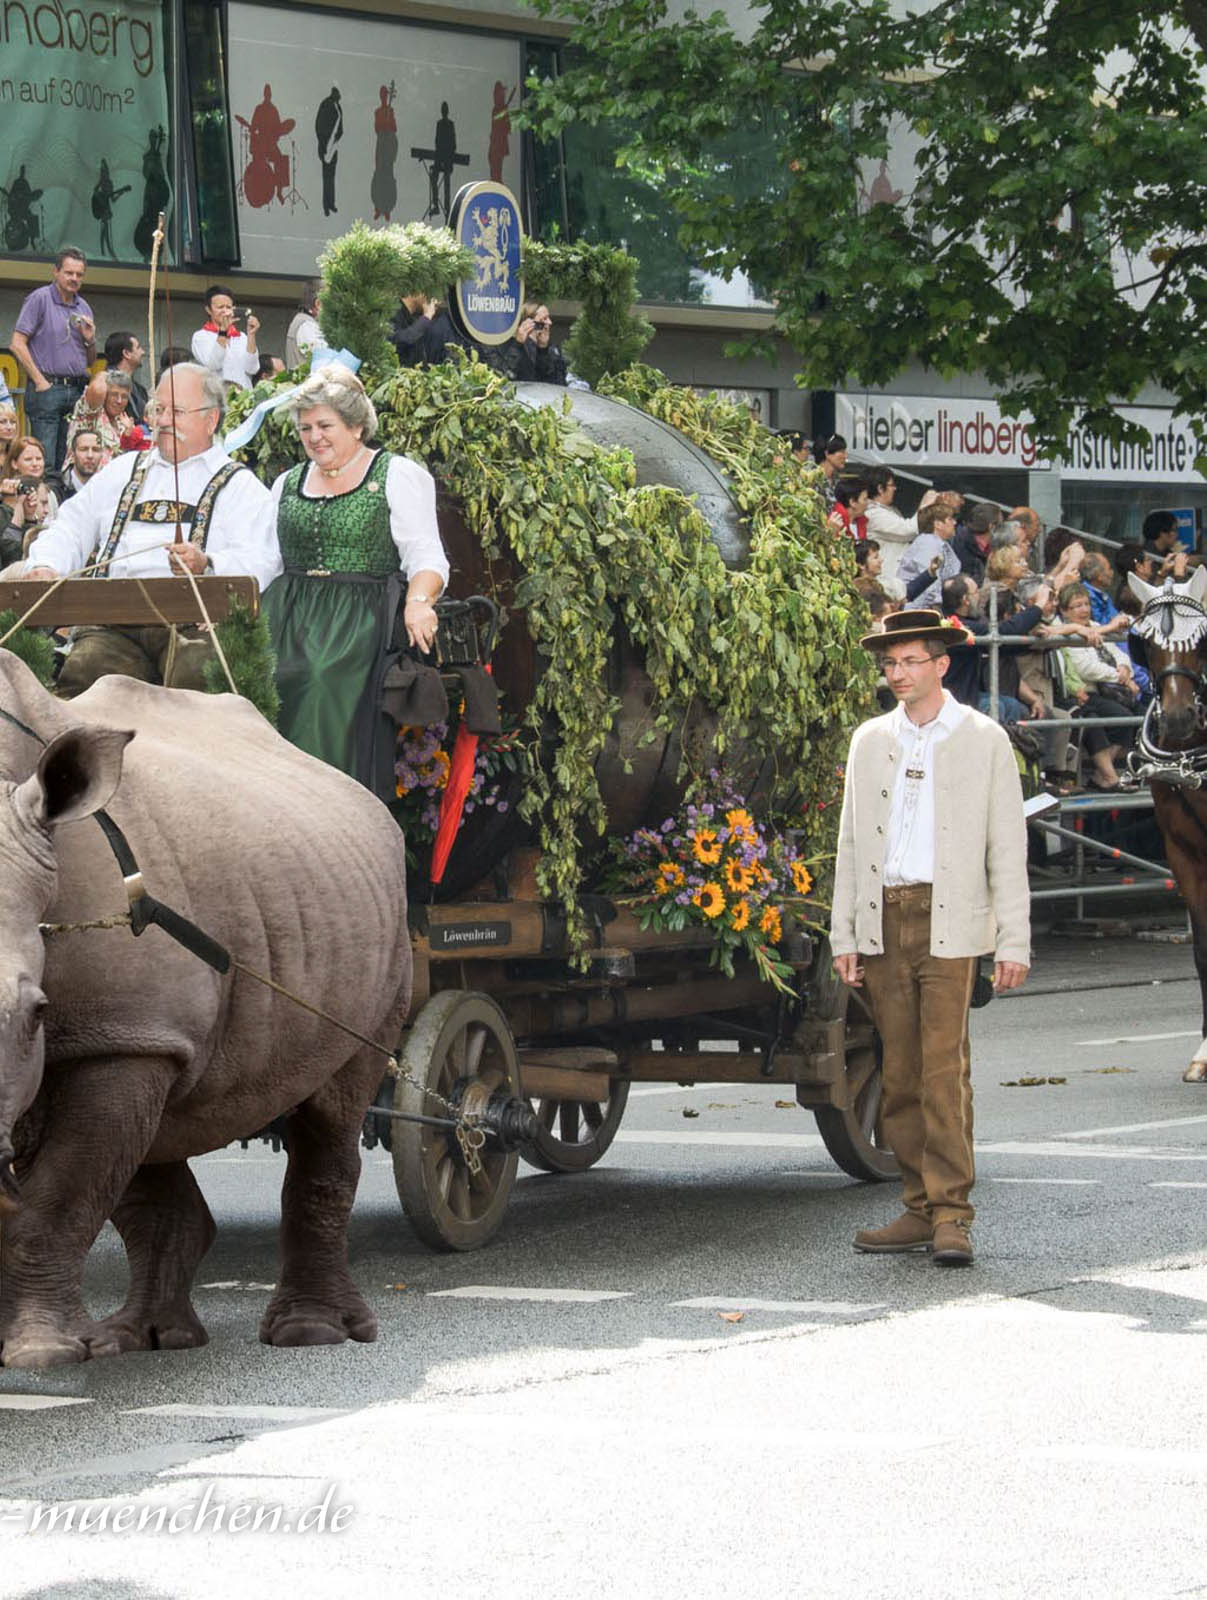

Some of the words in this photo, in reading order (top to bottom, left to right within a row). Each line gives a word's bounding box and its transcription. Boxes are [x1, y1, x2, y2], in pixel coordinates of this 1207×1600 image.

[19, 78, 57, 104] auf
[467, 294, 516, 313] LÖWENBRÄU
[853, 406, 934, 453] hieber
[937, 410, 1037, 467] lindberg
[1063, 422, 1187, 473] nstrumente
[443, 927, 497, 943] Löwenbräu
